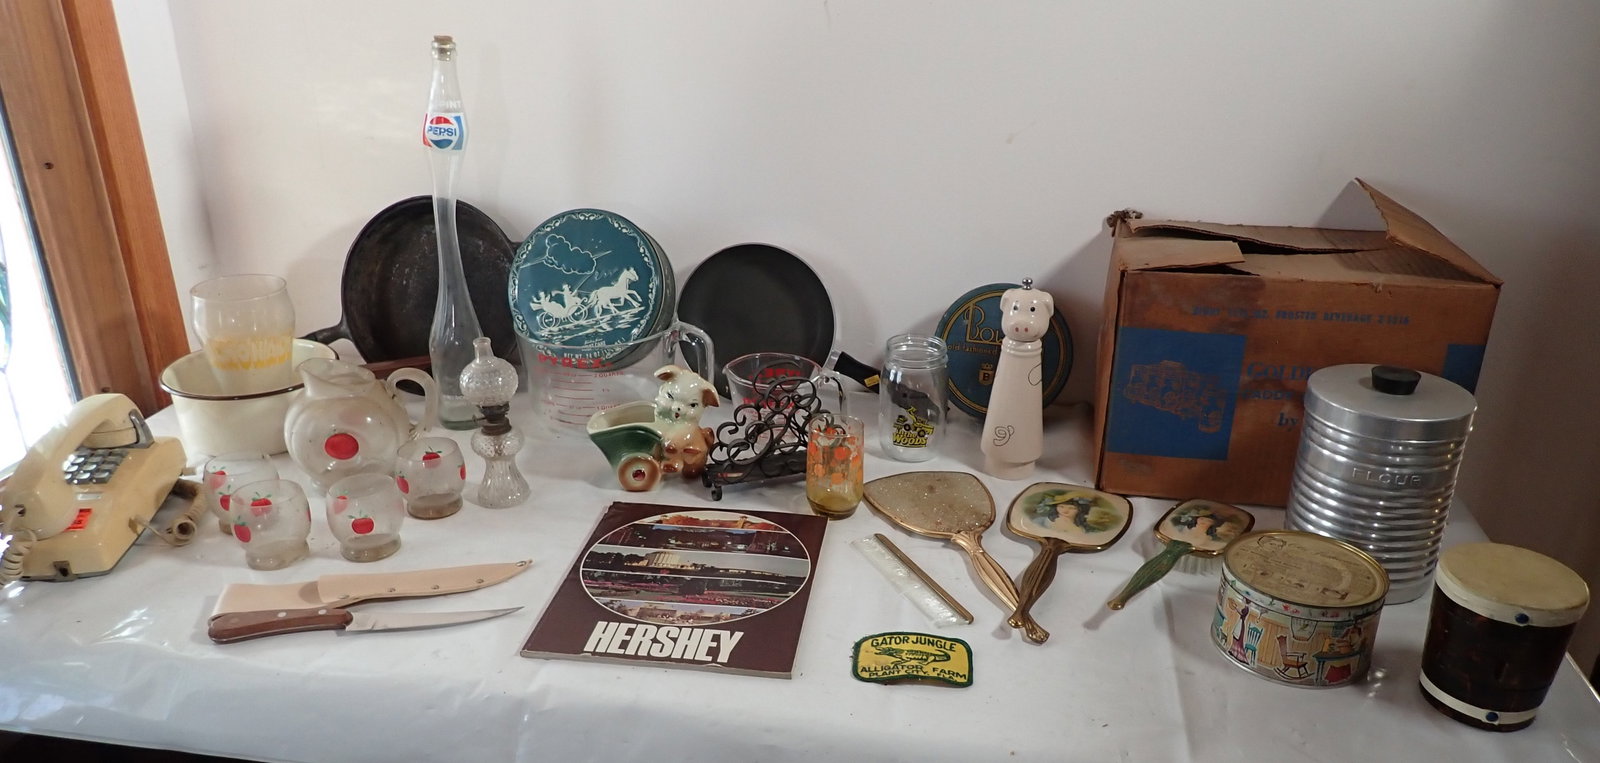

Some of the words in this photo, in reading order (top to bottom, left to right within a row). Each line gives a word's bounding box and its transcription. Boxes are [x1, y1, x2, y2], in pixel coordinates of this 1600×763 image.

[428, 126, 457, 137] PEPSI
[537, 352, 604, 369] PYREX
[982, 371, 990, 381] B
[1278, 412, 1298, 433] by
[893, 434, 928, 445] WOODS
[1352, 467, 1422, 486] FLOUR
[583, 620, 744, 663] HERSHEY
[870, 635, 910, 647] GATOR
[912, 636, 957, 652] JUNGLE
[860, 663, 924, 673] ALLIGATOR
[932, 667, 967, 680] FARM
[869, 669, 901, 678] PLANT
